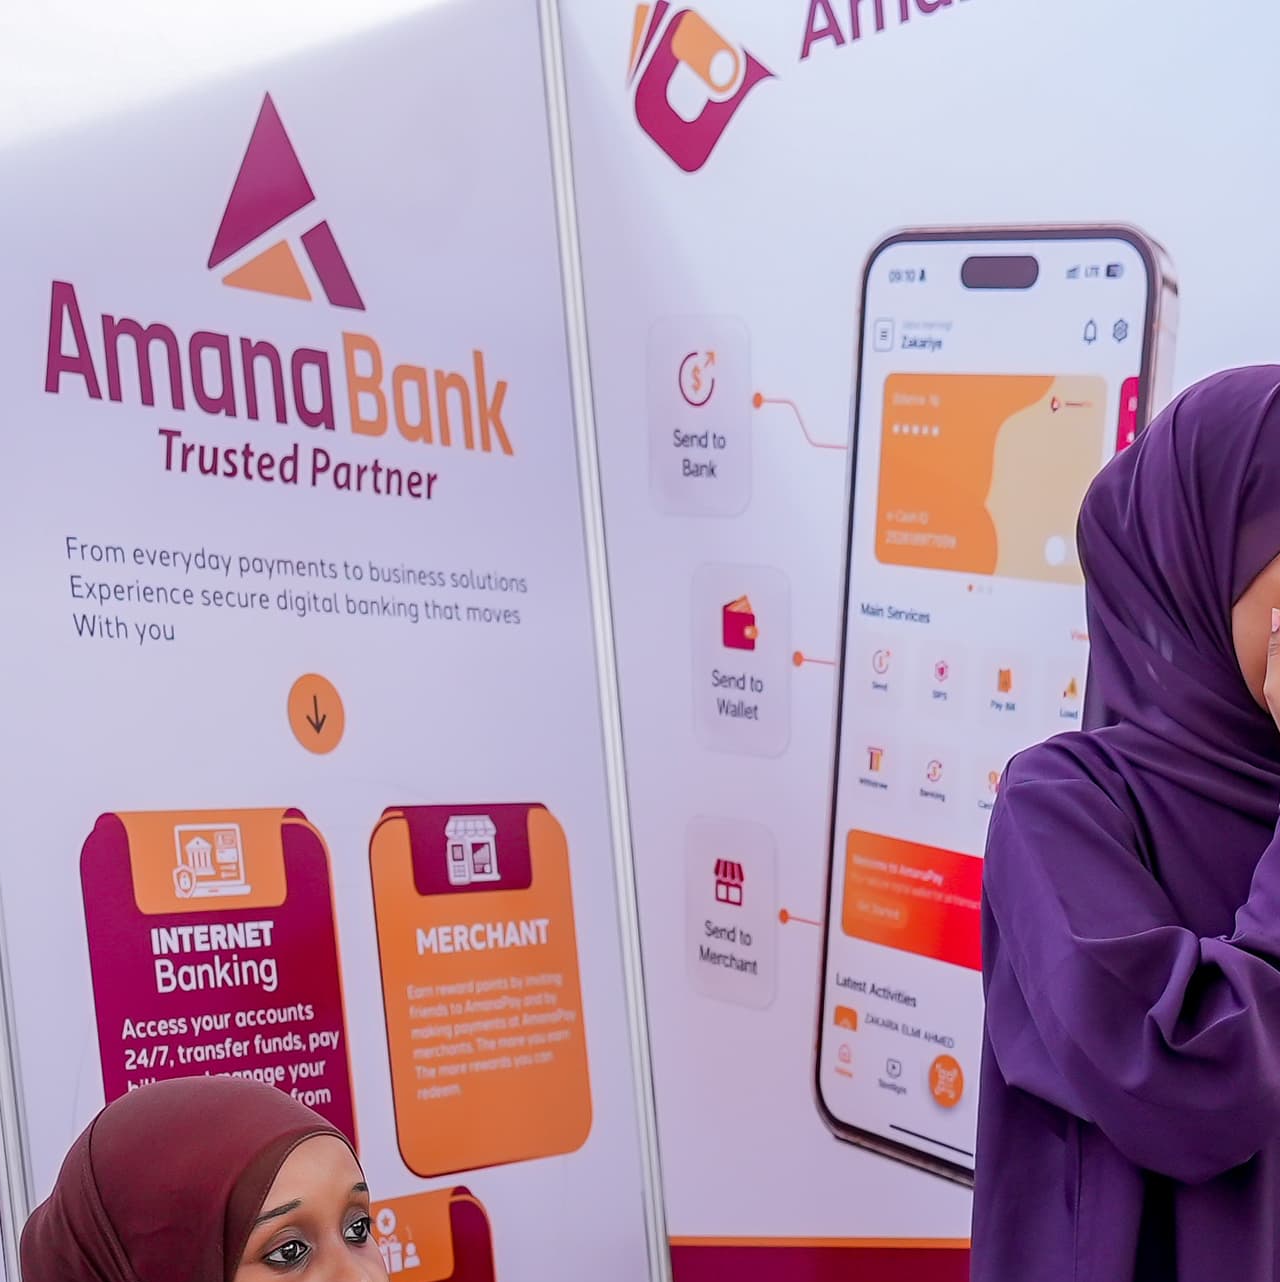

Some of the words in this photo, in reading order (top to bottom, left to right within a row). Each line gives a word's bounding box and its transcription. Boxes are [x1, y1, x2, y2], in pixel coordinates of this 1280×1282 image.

[45, 280, 513, 457] AmanaBank
[673, 429, 708, 448] Send
[713, 433, 726, 449] to
[159, 428, 298, 484] Trusted
[312, 448, 437, 499] Partner
[683, 459, 716, 477] Bank
[66, 537, 125, 563] From
[133, 548, 231, 576] everyday
[239, 557, 337, 579] payments
[344, 561, 363, 580] to
[369, 561, 446, 587] business
[450, 569, 527, 593] solutions
[71, 575, 193, 606] Experience
[201, 590, 269, 609] secure
[277, 589, 339, 617] digital
[345, 594, 419, 623] banking
[424, 600, 461, 621] that
[467, 607, 520, 624] moves
[73, 614, 128, 638] With
[135, 624, 174, 645] you
[151, 921, 273, 954] INTERNET
[417, 919, 549, 954] MERCHANT
[155, 955, 277, 992] Banking
[122, 1018, 187, 1039] Access
[191, 1013, 231, 1036] your
[235, 1004, 314, 1027] accounts
[125, 1046, 174, 1069] 24/7,
[178, 1038, 249, 1063] transfer
[254, 1032, 306, 1053] funds,
[309, 1031, 339, 1052] pay
[288, 1061, 325, 1083] your
